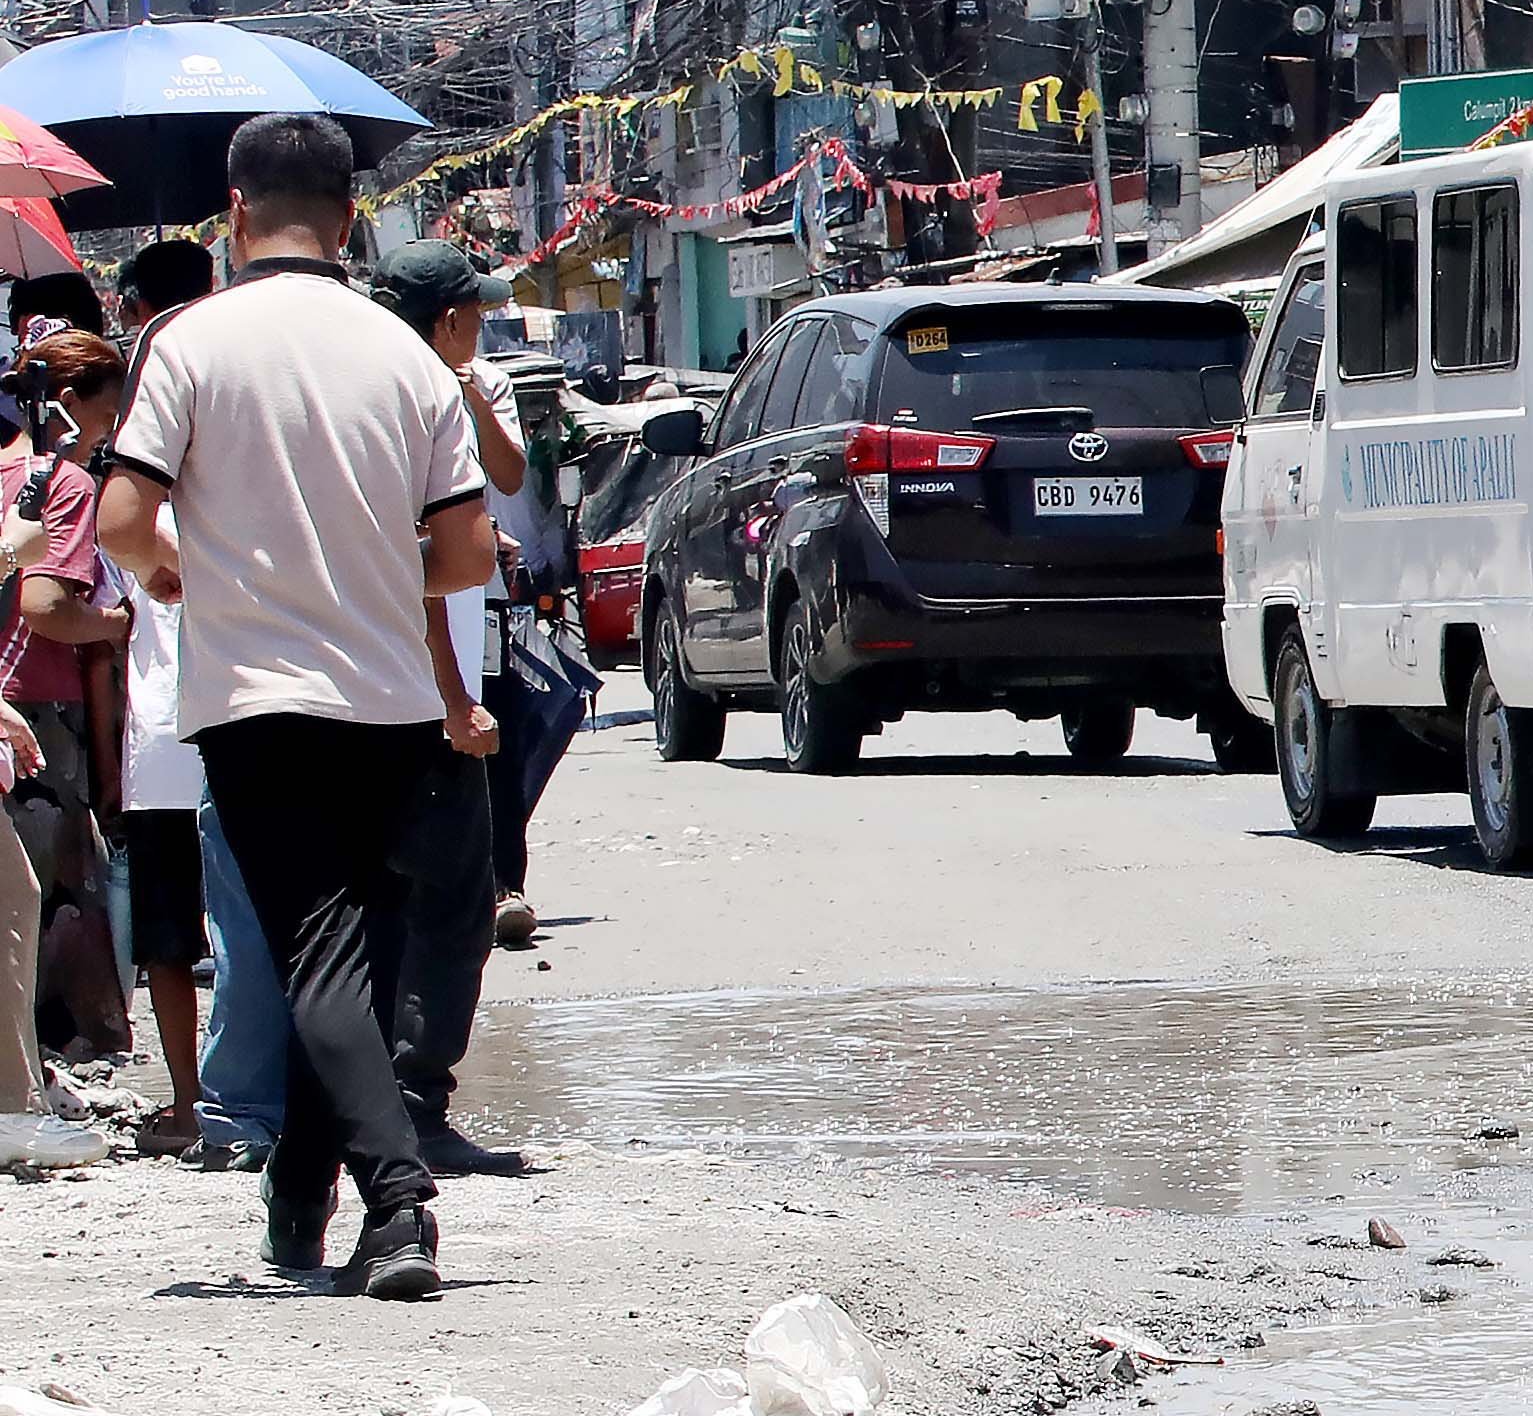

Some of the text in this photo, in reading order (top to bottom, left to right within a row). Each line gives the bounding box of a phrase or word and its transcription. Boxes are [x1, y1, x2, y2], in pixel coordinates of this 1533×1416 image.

[170, 74, 225, 87] You're
[162, 83, 268, 101] good hands
[1463, 96, 1507, 123] Calumpit
[916, 330, 947, 348] D264
[1452, 436, 1469, 503] OF
[900, 482, 955, 494] INNOVA
[1037, 483, 1140, 508] CBD 9476
